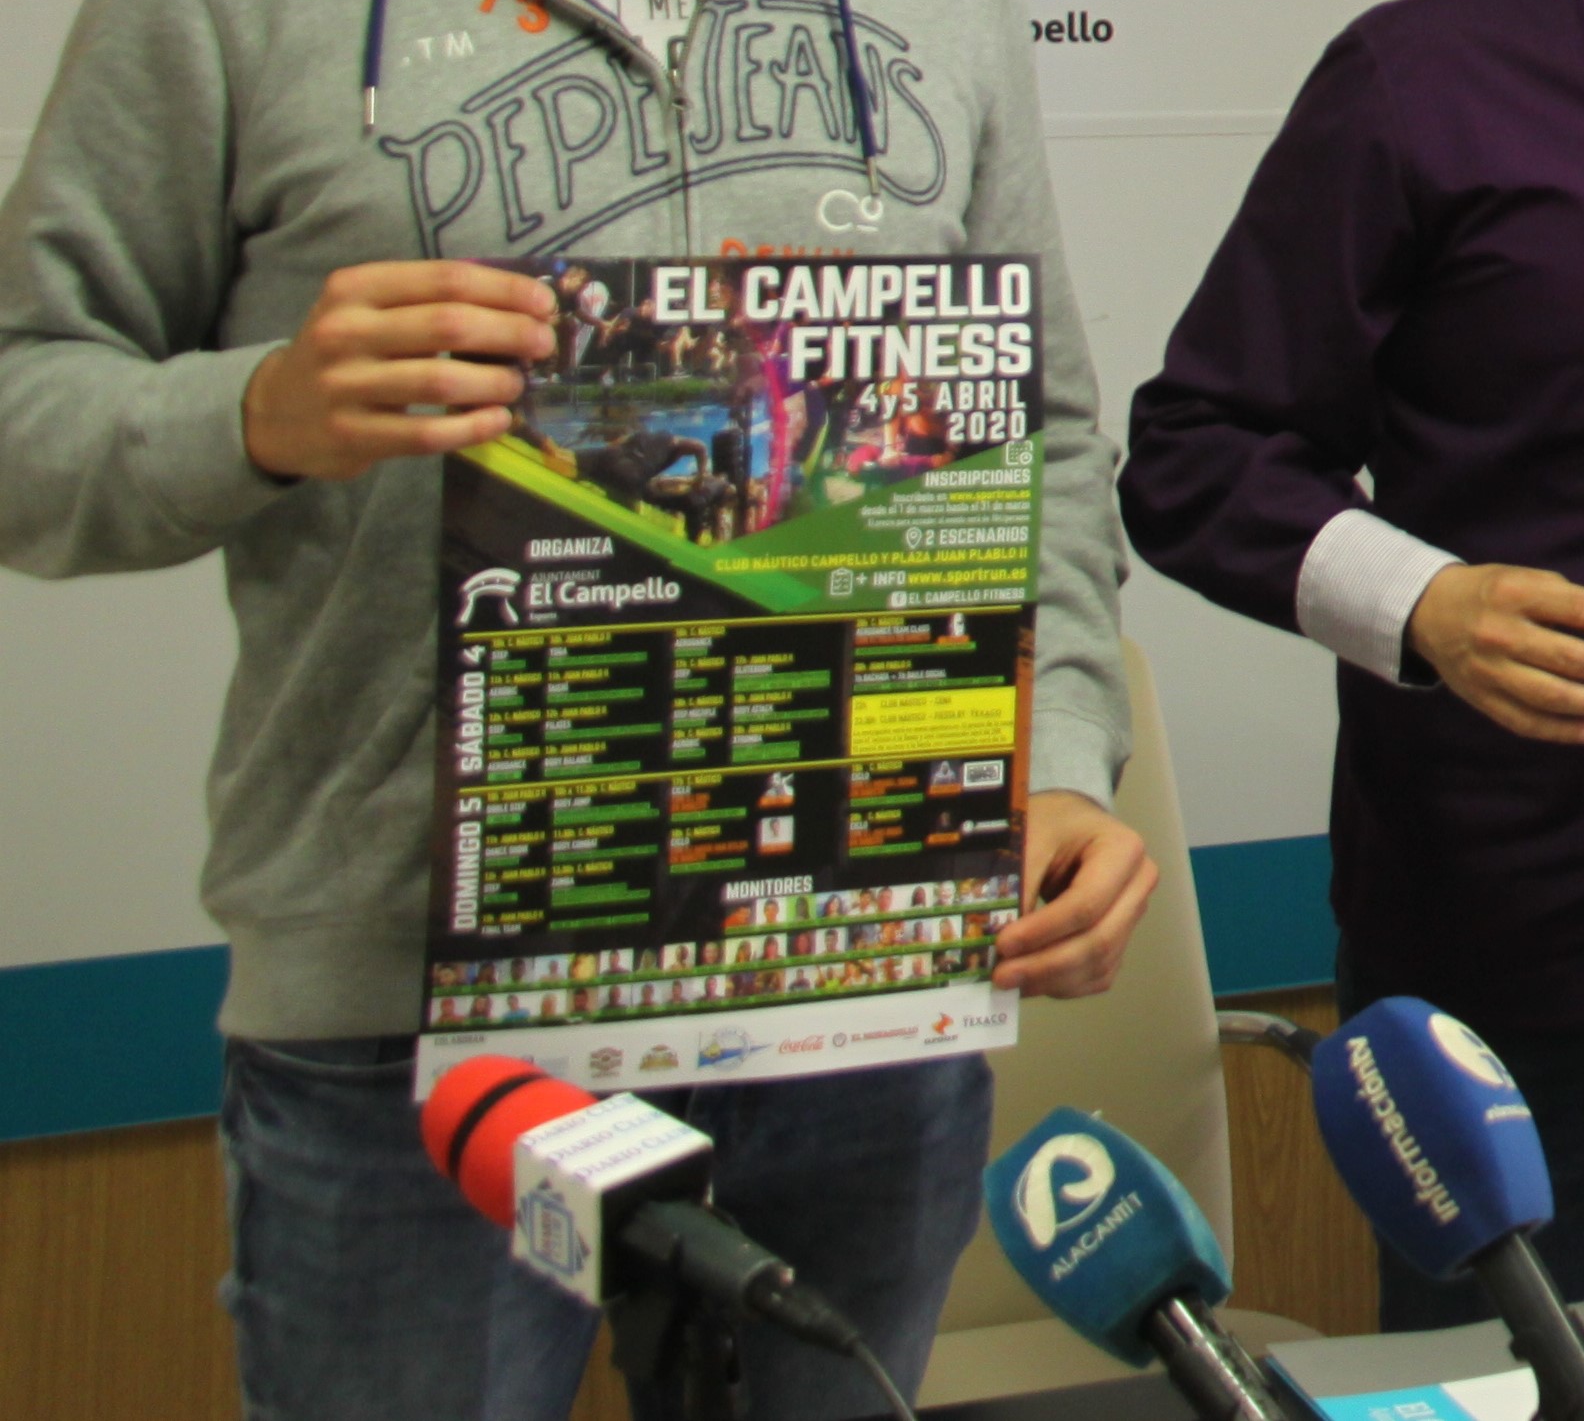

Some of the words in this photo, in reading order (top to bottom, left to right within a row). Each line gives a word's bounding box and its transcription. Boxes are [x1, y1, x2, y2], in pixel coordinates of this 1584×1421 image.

[380, 55, 676, 262] PEPE
[655, 266, 724, 323] EL
[745, 263, 1031, 318] CAMPELLO
[791, 323, 1032, 380] FITNESS
[936, 380, 1026, 412] ABRIL
[949, 412, 1027, 443] 2020
[924, 468, 1031, 488] INSCRIPCIONES
[530, 537, 614, 559] ORGANIZA
[924, 533, 936, 550] 2
[939, 529, 1029, 549] ESCENARIOS
[715, 557, 750, 572] CLUB
[752, 553, 808, 570] NÁUTICO
[811, 552, 878, 568] CAMPELLO
[880, 552, 888, 564] Y
[889, 550, 930, 564] PLAZA
[934, 549, 966, 562] JUAN
[873, 571, 906, 587] INFO
[908, 567, 1028, 585] www.sportrun.es
[530, 583, 553, 606] El
[560, 577, 680, 609] Campello
[909, 591, 922, 604] EL
[925, 588, 980, 603] CAMPELLO
[982, 587, 1025, 601] FITNESS
[463, 644, 485, 665] 4
[457, 672, 486, 772] SÁBADO
[460, 797, 481, 815] 5
[455, 822, 481, 930] DOMINGO
[725, 875, 813, 900] MONITORES
[961, 1012, 1007, 1030] TEXACO
